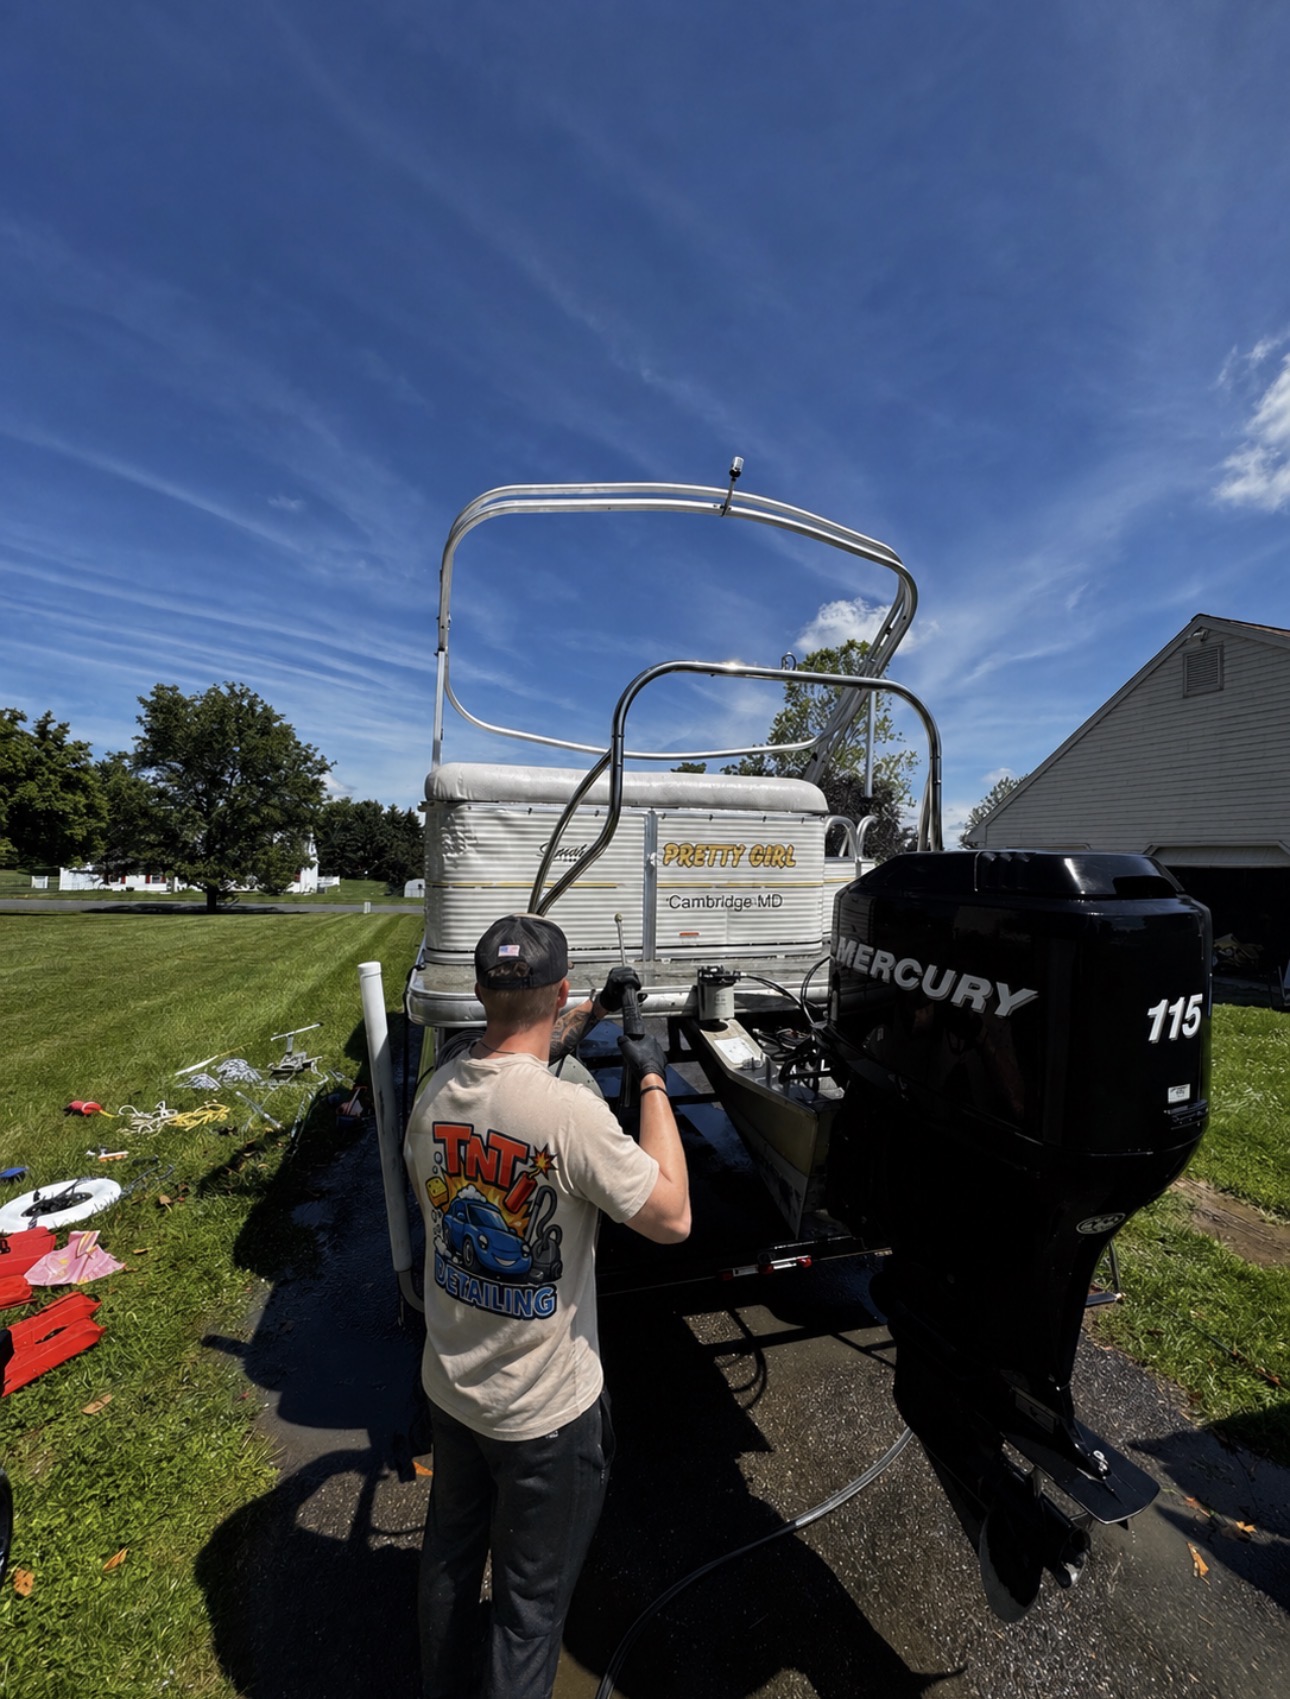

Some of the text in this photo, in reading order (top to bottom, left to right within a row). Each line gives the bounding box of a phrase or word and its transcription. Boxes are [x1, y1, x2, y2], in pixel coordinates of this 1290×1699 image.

[663, 842, 796, 869] PRETTY GIRL
[668, 893, 783, 912] Cambridge MD
[836, 936, 1039, 1018] MERCURY
[1147, 993, 1203, 1044] 115
[432, 1121, 530, 1191] TNT
[434, 1252, 558, 1320] DETAILING
